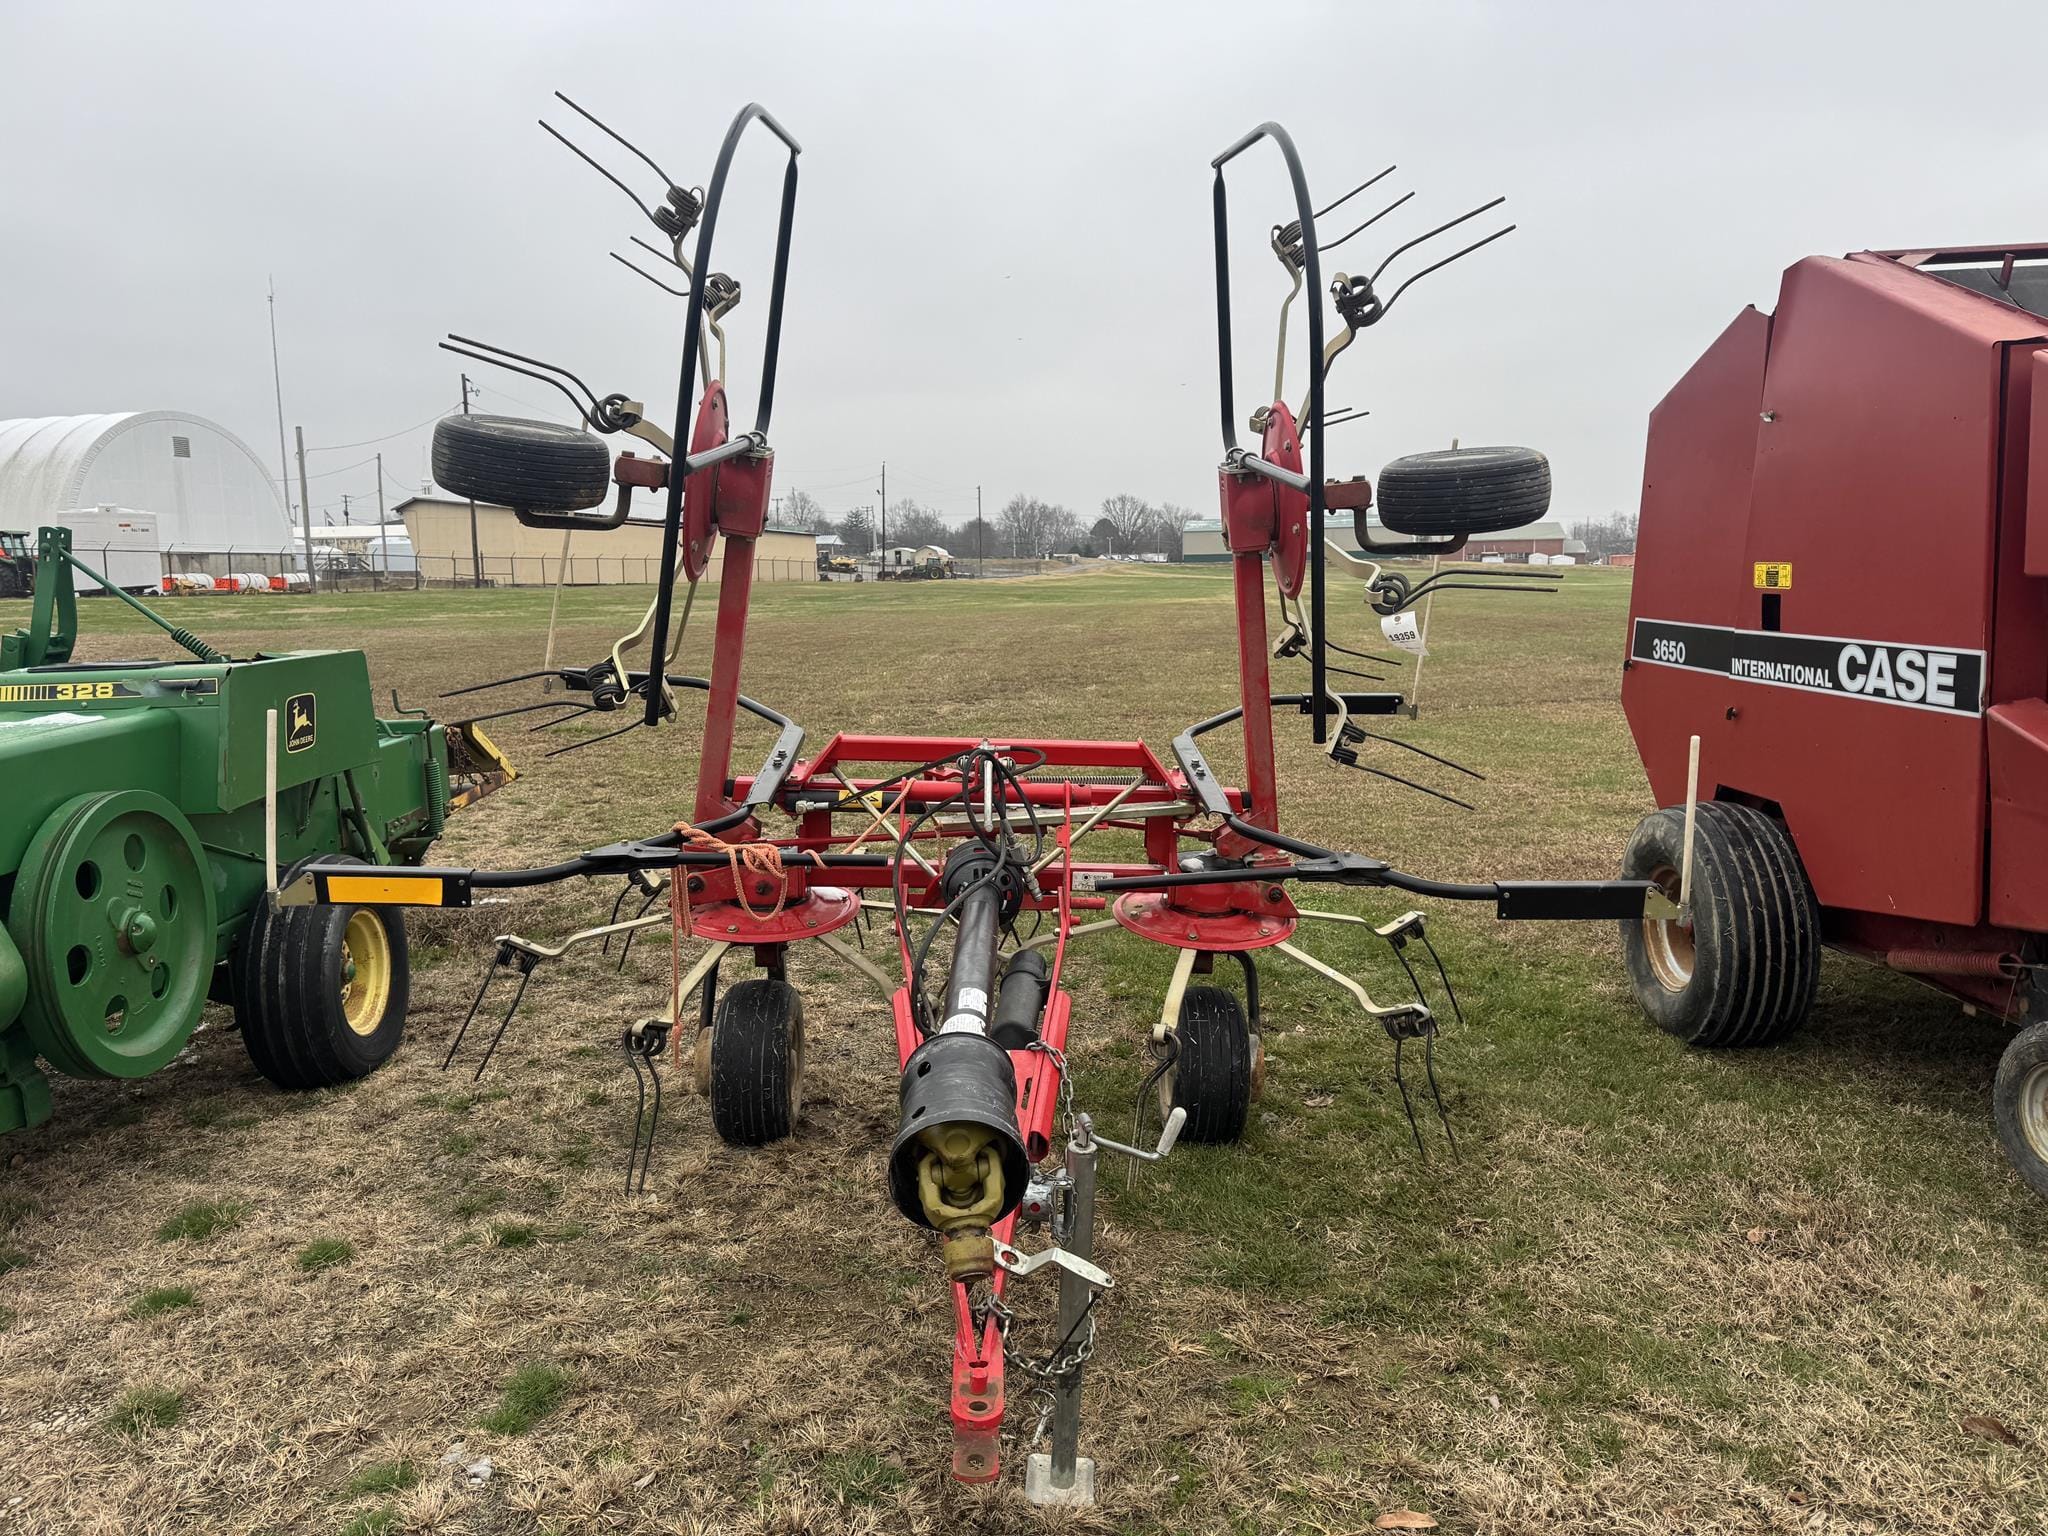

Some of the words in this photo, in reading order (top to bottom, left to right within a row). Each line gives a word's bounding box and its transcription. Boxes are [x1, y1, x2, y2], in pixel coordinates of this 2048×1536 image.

[1389, 631, 1416, 642] 19359
[1652, 638, 1686, 664] 3650
[1731, 657, 1833, 688] INTERNATIONAL
[1837, 644, 1958, 707] CASE
[56, 683, 114, 699] 328
[288, 738, 300, 748] JOHN
[300, 734, 314, 745] DEERE
